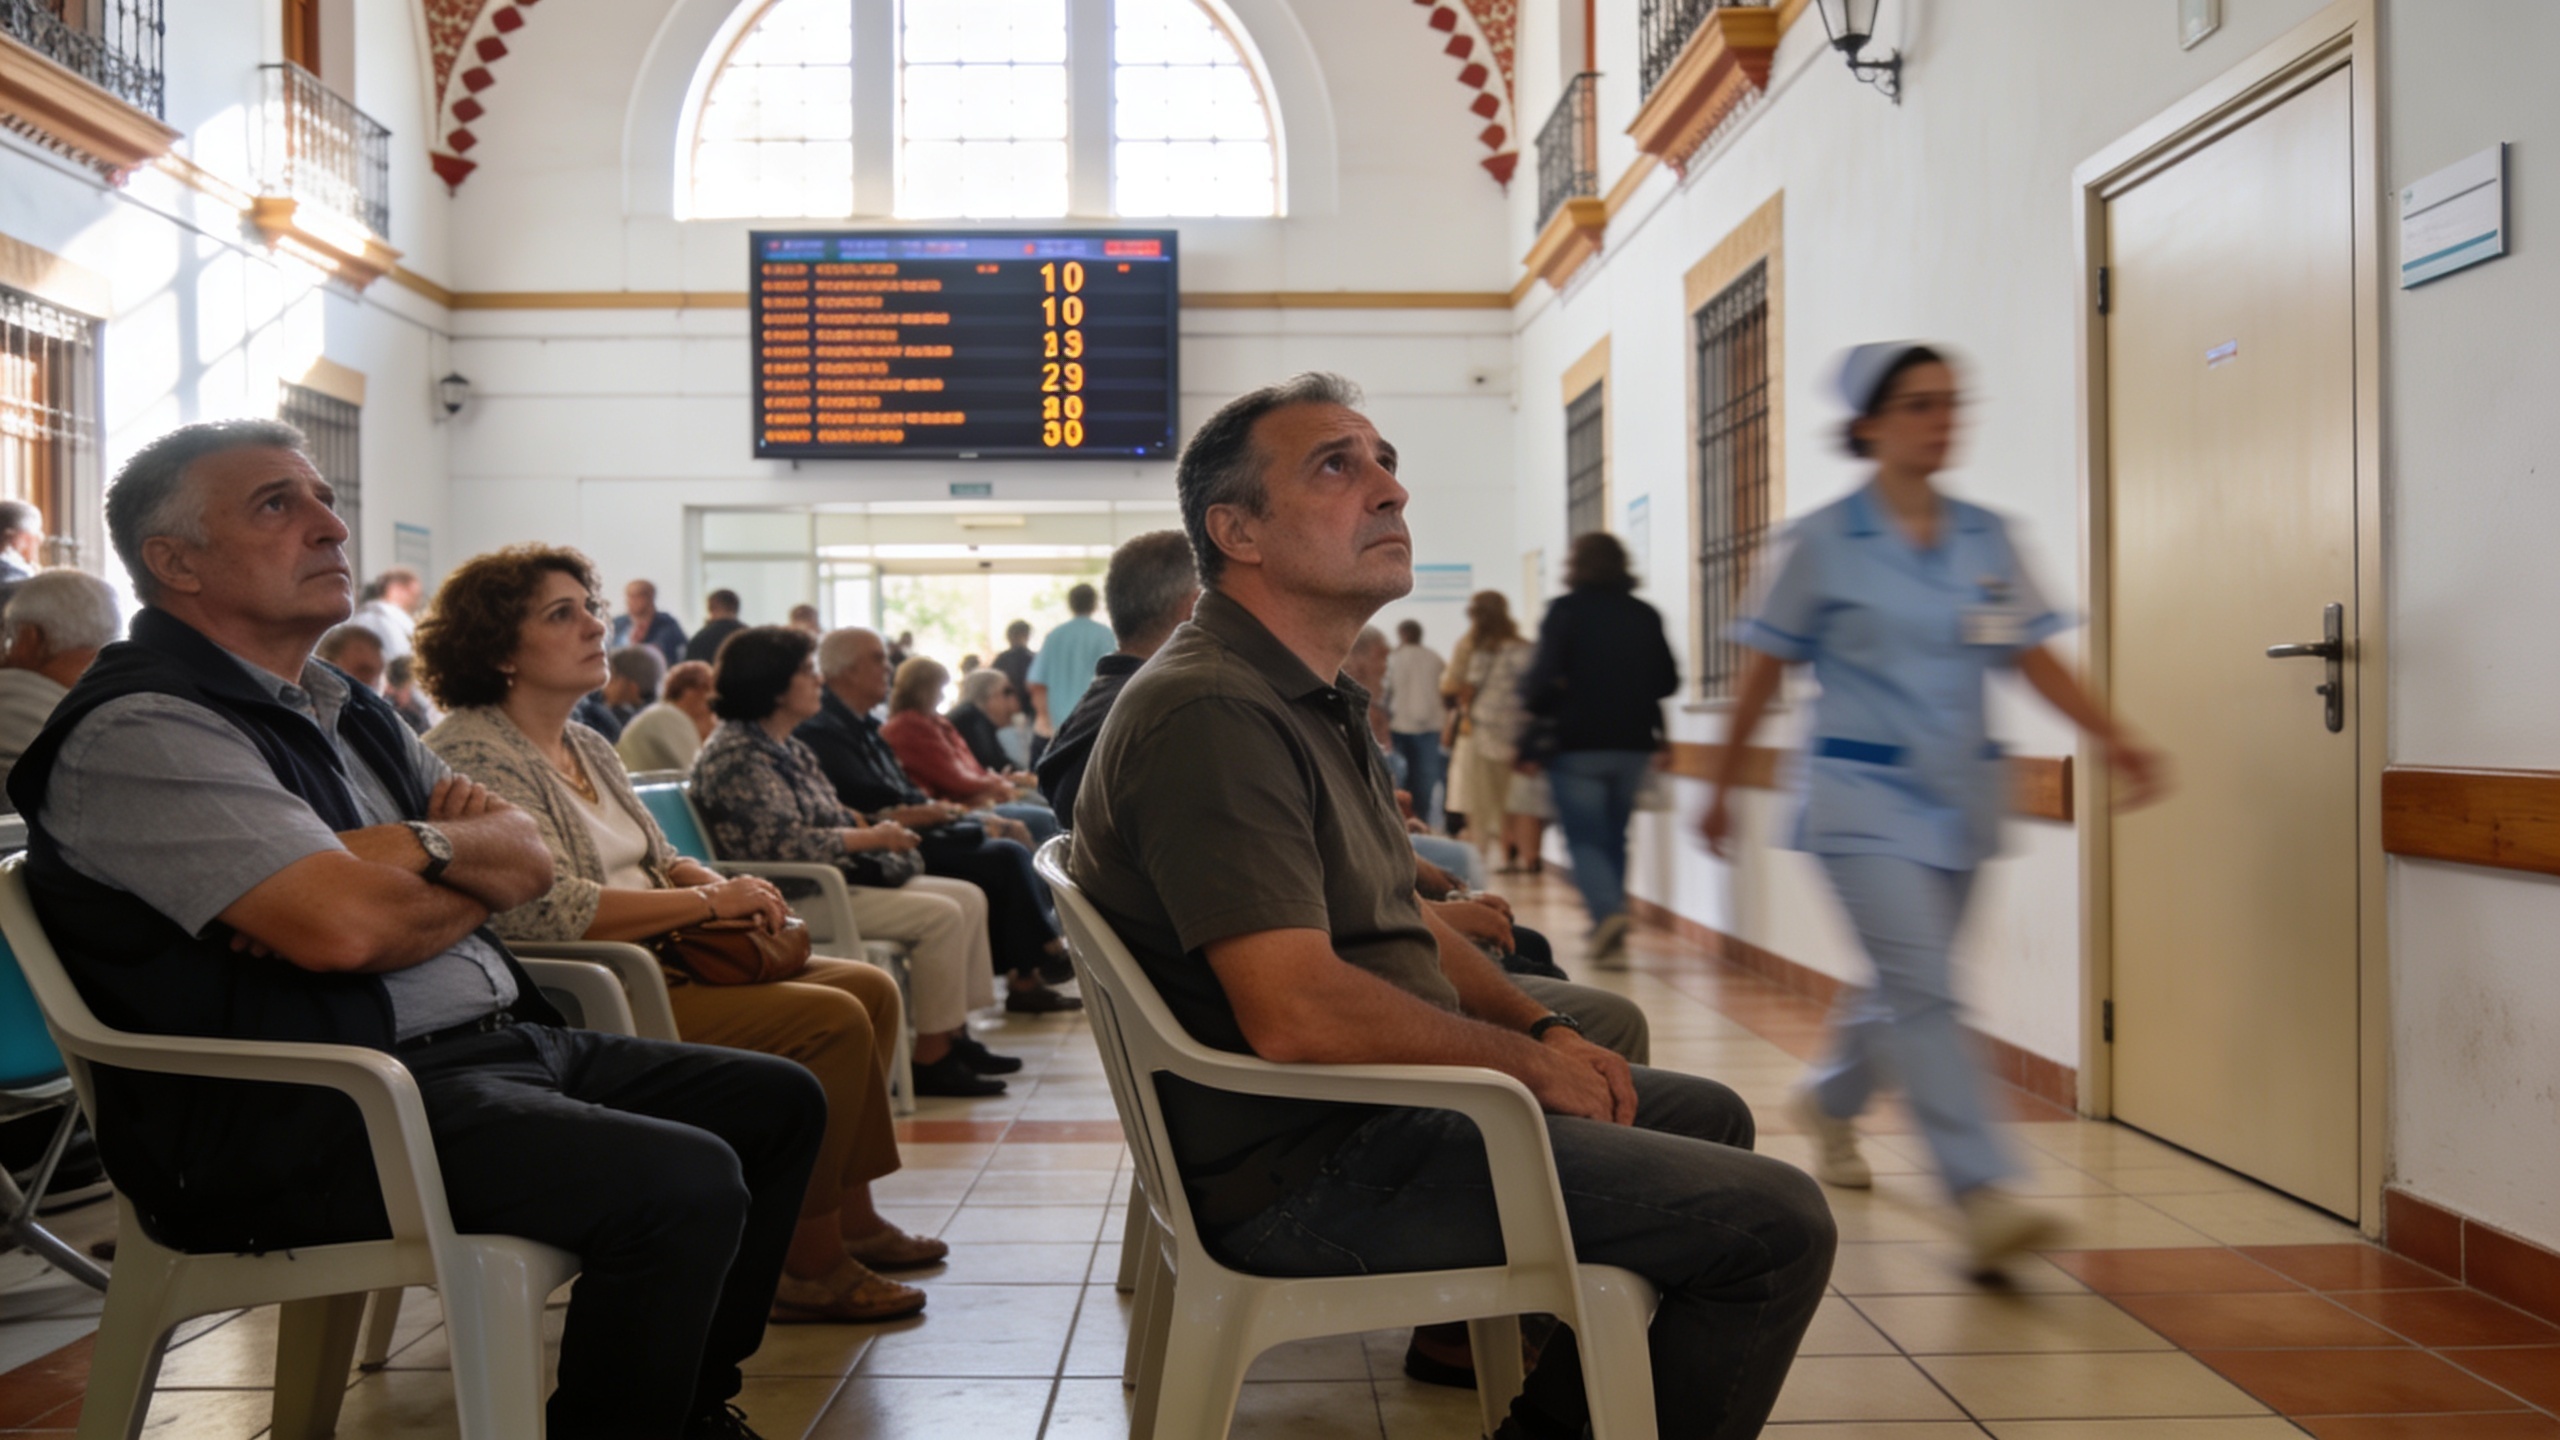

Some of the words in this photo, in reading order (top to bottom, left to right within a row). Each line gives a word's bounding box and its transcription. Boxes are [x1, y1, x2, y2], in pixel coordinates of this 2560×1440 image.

[1040, 262, 1085, 293] 10
[1042, 295, 1084, 326] 10
[1041, 362, 1084, 393] 29
